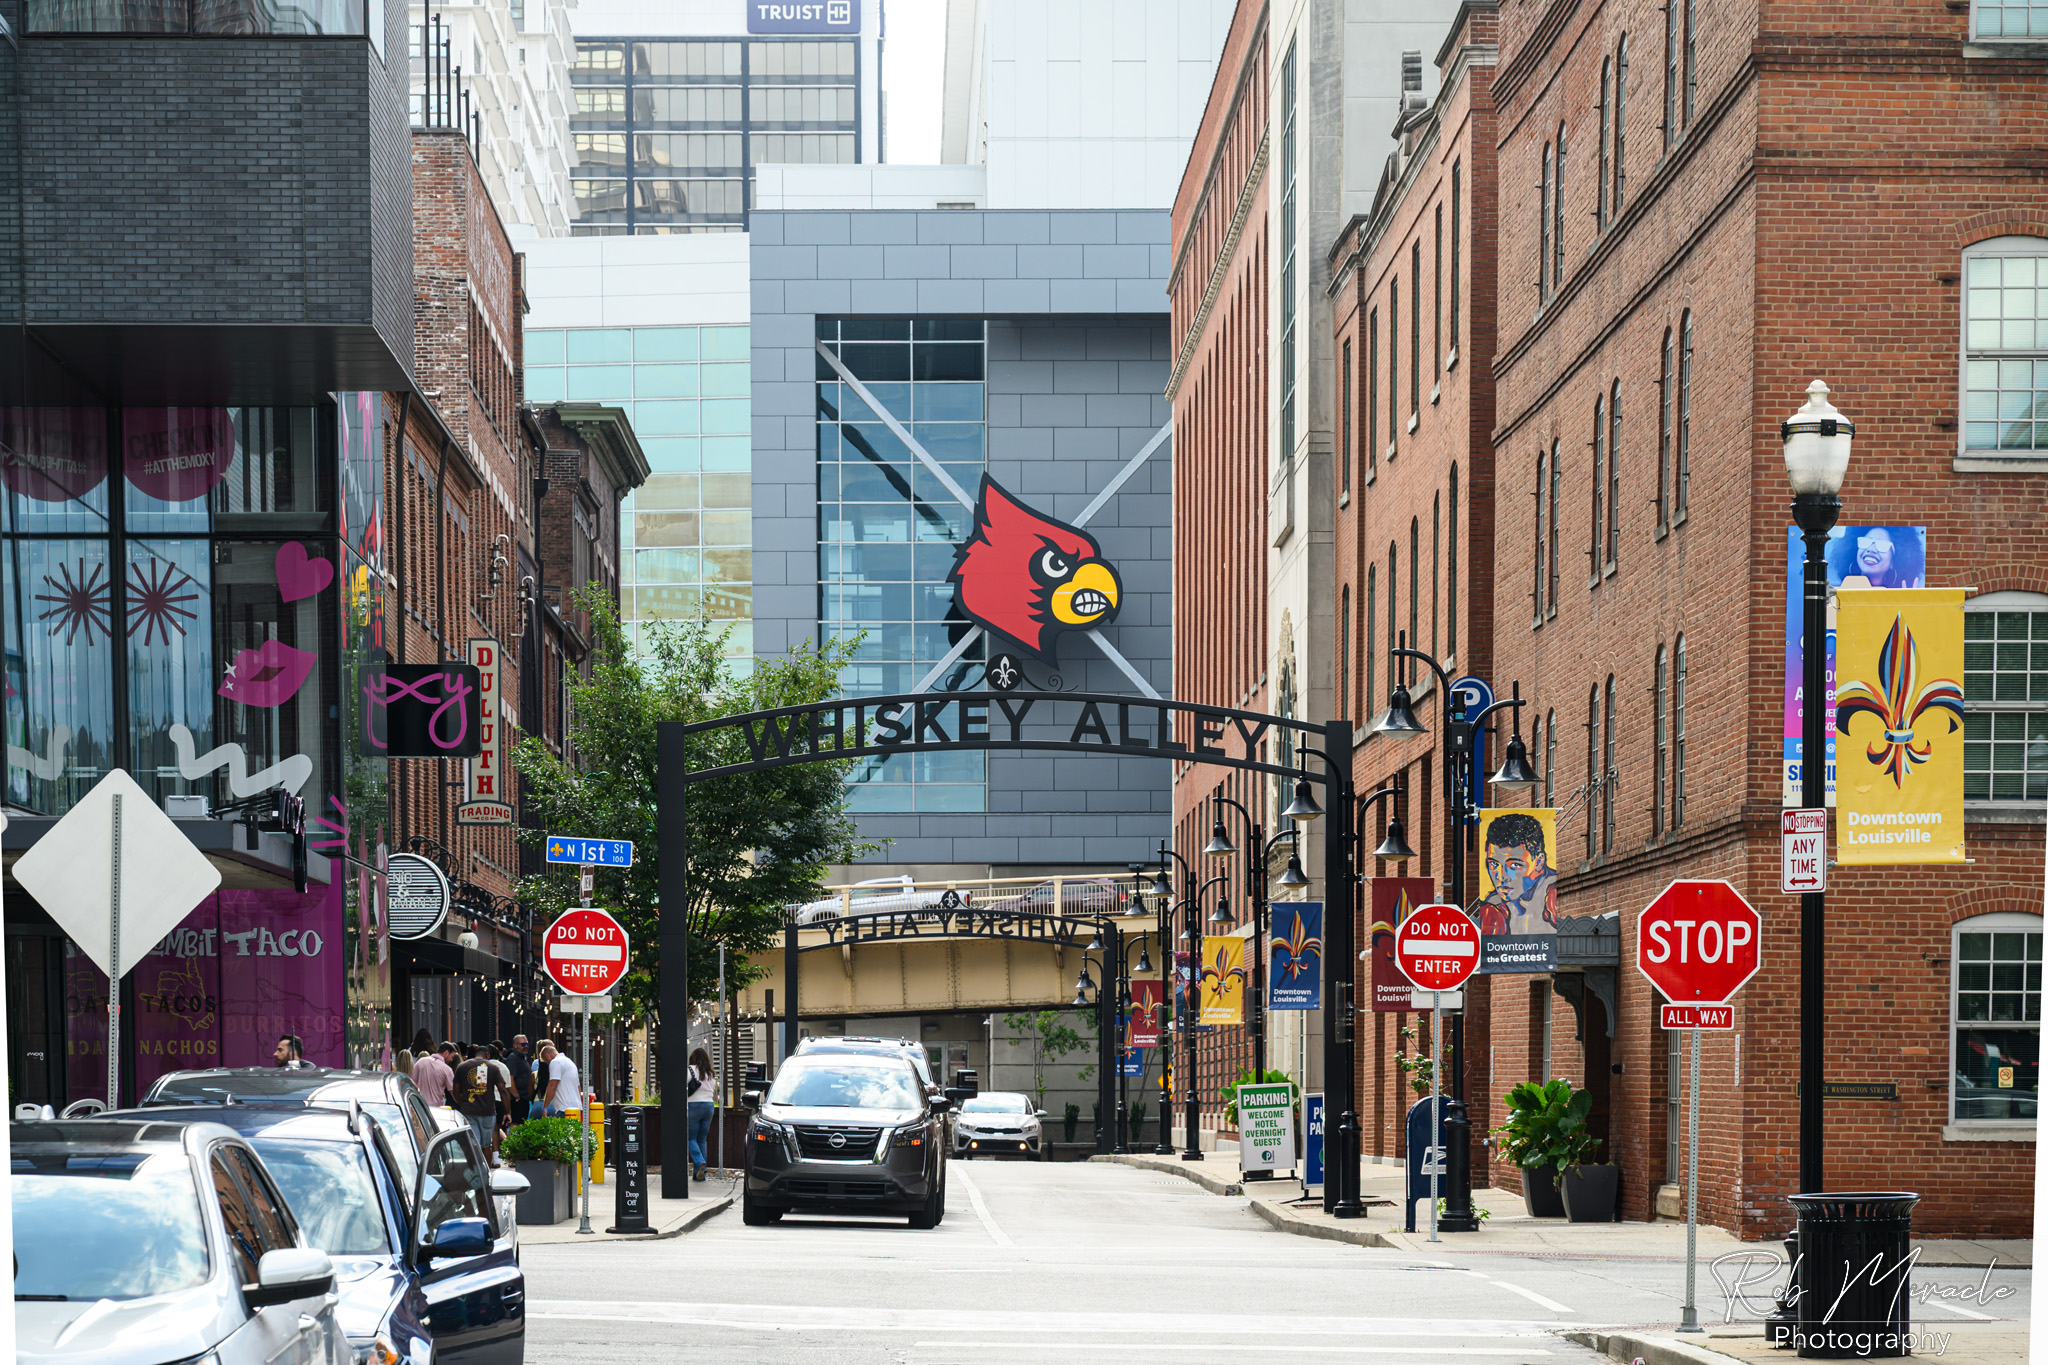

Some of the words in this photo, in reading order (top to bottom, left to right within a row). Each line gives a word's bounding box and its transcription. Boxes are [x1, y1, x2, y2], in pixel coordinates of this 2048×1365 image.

[757, 4, 824, 20] TRUIST
[128, 426, 201, 460] CHECK
[143, 451, 215, 476] #ATTHEMOXY
[476, 647, 494, 795] DULUTH
[741, 698, 1036, 763] WHISKEY
[1069, 700, 1270, 763] ALLEY
[460, 806, 510, 820] TRADING
[1848, 811, 1942, 826] Downtown
[1784, 814, 1796, 831] NO
[1795, 815, 1824, 829] STOPPING
[1848, 828, 1931, 845] Louisville
[566, 844, 575, 857] N
[581, 842, 606, 862] 1st
[613, 843, 624, 854] St
[1791, 838, 1816, 855] ANY
[612, 855, 624, 863] 100
[1790, 858, 1817, 874] TIME
[396, 884, 409, 897] &
[557, 926, 577, 940] DO
[585, 927, 616, 941] NOT
[1411, 921, 1431, 936] DO
[1438, 923, 1469, 937] NOT
[223, 926, 325, 957] TACO
[1487, 941, 1539, 952] Downtown
[1541, 941, 1549, 951] is
[1646, 919, 1752, 964] STOP
[1487, 955, 1500, 963] the
[1500, 952, 1547, 963] Greatest
[561, 963, 608, 978] ENTER
[1414, 959, 1461, 974] ENTER
[1377, 984, 1418, 993] Downtow
[144, 995, 216, 1013] TACOS
[1377, 993, 1411, 1002] Louisvil
[225, 1014, 344, 1034] BURRITOS
[1667, 1010, 1693, 1024] ALL
[1700, 1010, 1728, 1024] WAY
[140, 1039, 217, 1056] NACHOS
[1831, 1086, 1868, 1094] WASHINGTON
[1869, 1086, 1891, 1094] STREET
[1242, 1091, 1288, 1107] PARKING
[1247, 1109, 1285, 1120] WELCOME
[1254, 1119, 1279, 1129] HOTEL
[1245, 1128, 1287, 1138] OVERNIGHT
[1253, 1137, 1282, 1147] GUESTS
[626, 1160, 638, 1168] Pick
[628, 1168, 637, 1177] Up
[625, 1190, 640, 1200] Drop
